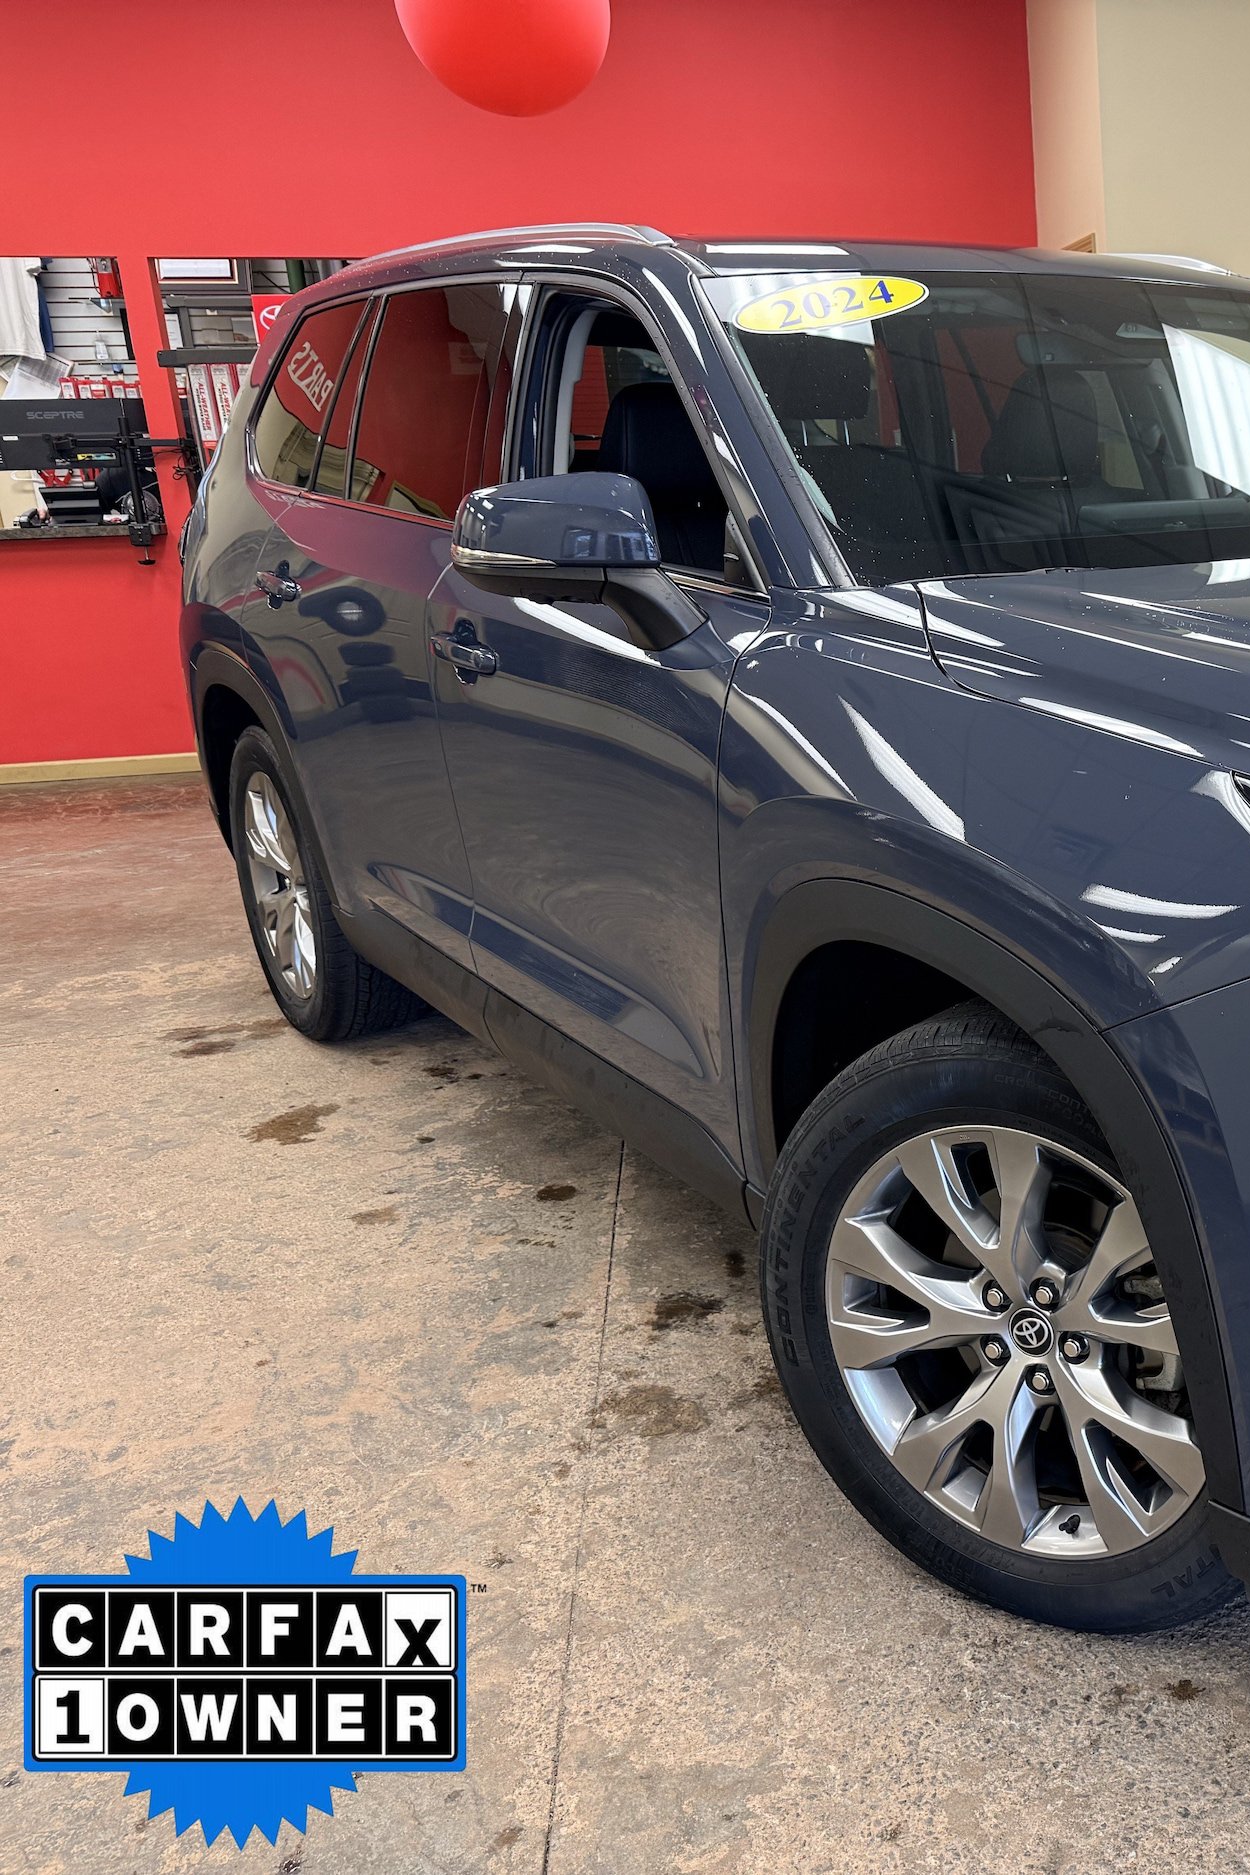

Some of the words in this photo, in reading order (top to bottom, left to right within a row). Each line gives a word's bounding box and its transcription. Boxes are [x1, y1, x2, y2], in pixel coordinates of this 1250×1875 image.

[771, 280, 894, 328] 2024
[26, 411, 85, 419] SCEPTRE
[775, 1114, 866, 1367] CONTINENTAL
